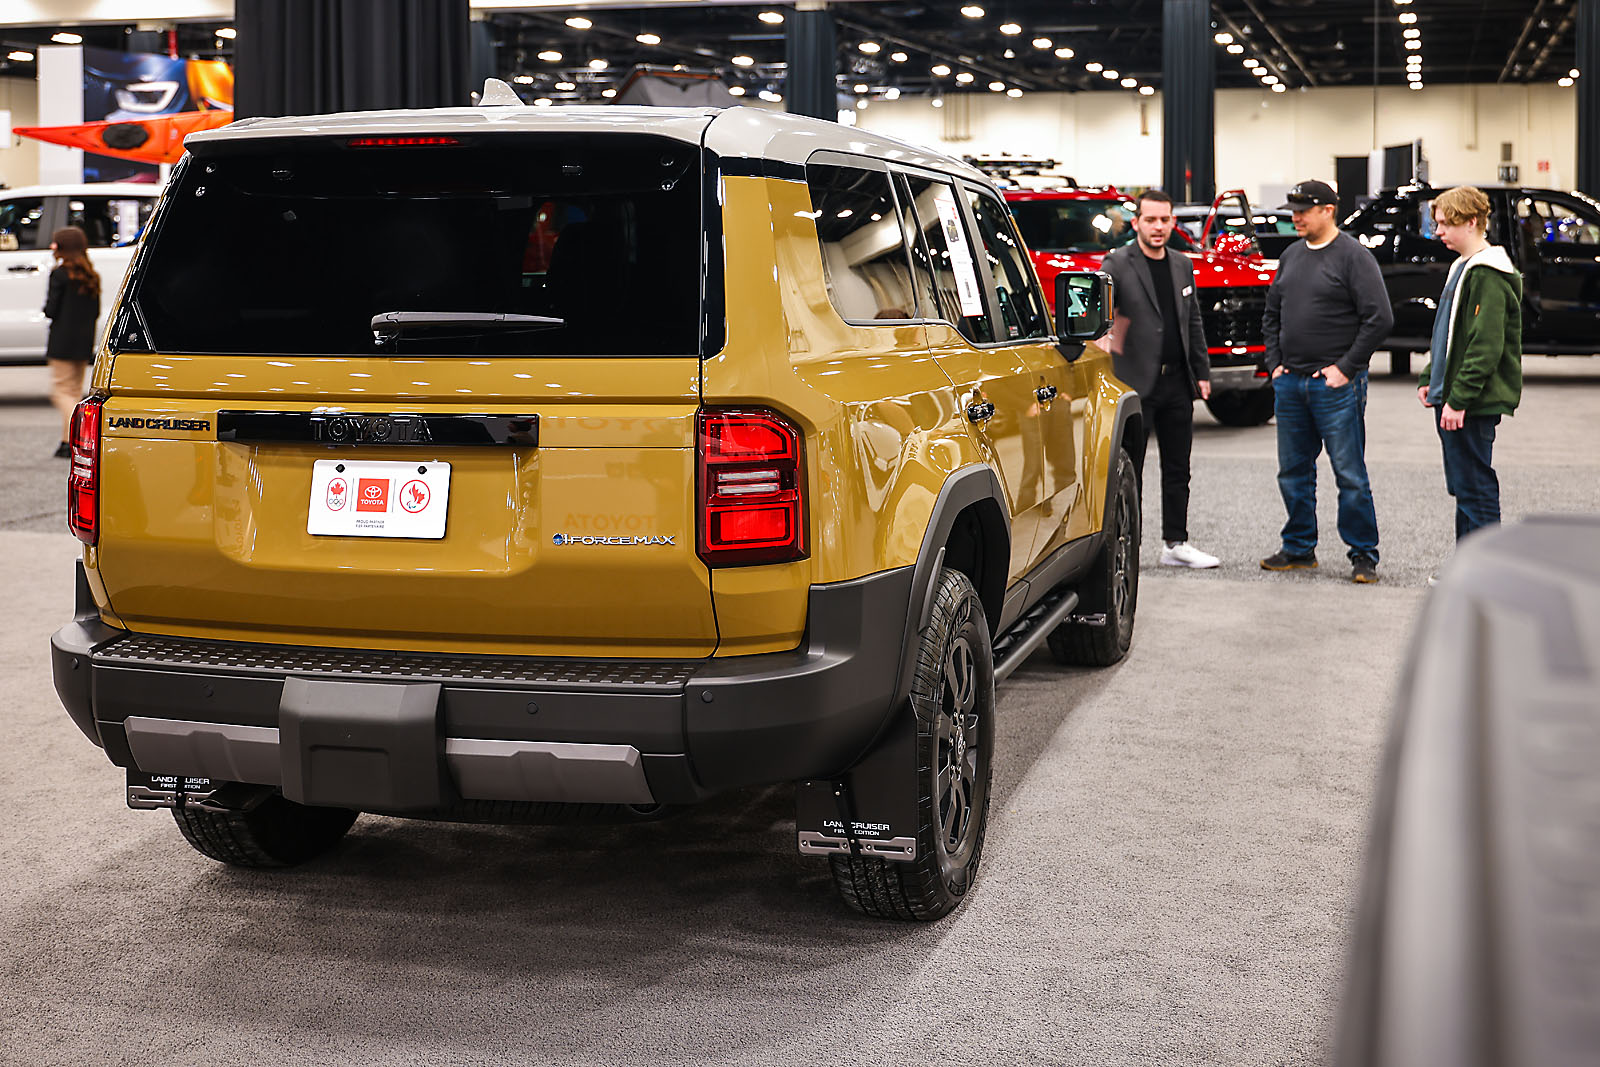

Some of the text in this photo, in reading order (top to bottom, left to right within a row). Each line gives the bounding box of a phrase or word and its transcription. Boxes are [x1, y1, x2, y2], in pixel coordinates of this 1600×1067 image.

[109, 417, 210, 431] LAND CRUISER
[309, 417, 433, 442] TOYOTA
[633, 536, 676, 545] MAX
[174, 776, 210, 784] CUISER
